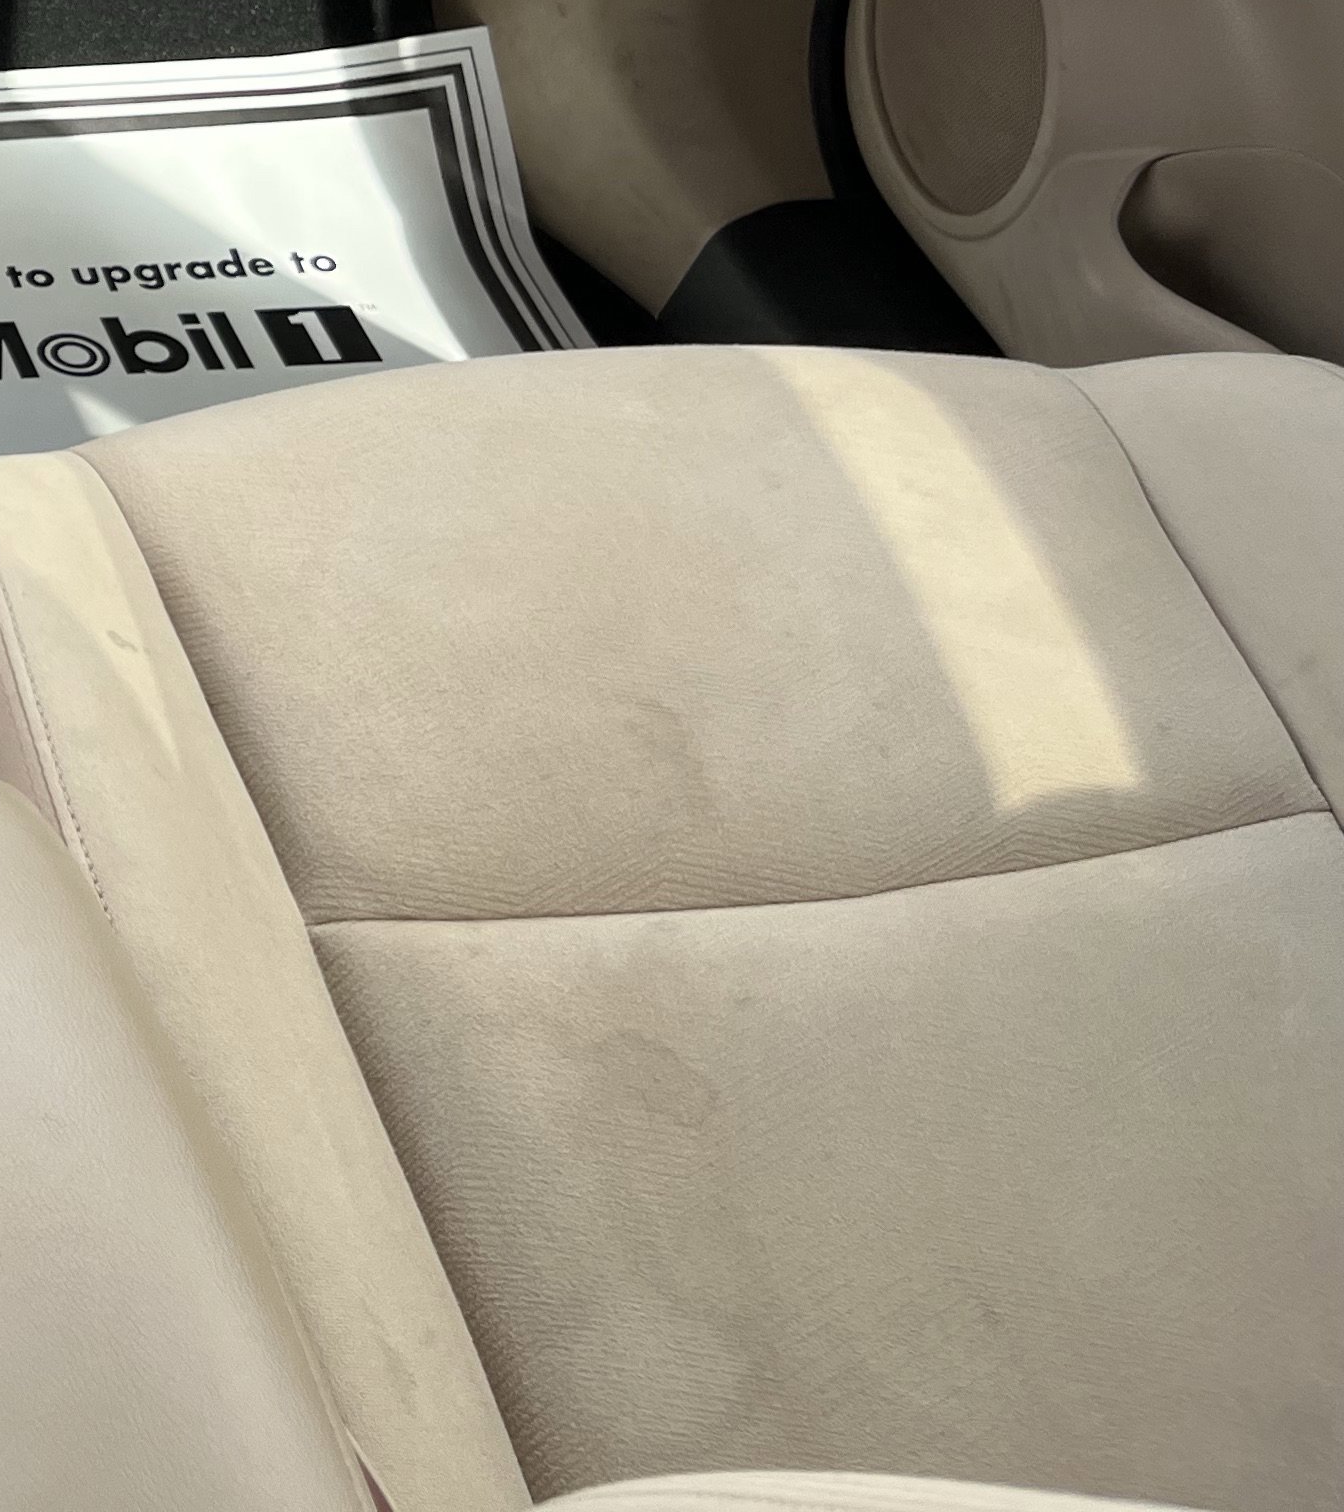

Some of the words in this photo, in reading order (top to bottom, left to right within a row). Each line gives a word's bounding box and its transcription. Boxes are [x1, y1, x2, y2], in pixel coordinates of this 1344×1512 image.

[5, 262, 55, 289] to
[70, 247, 275, 292] upgrade
[289, 250, 338, 274] to
